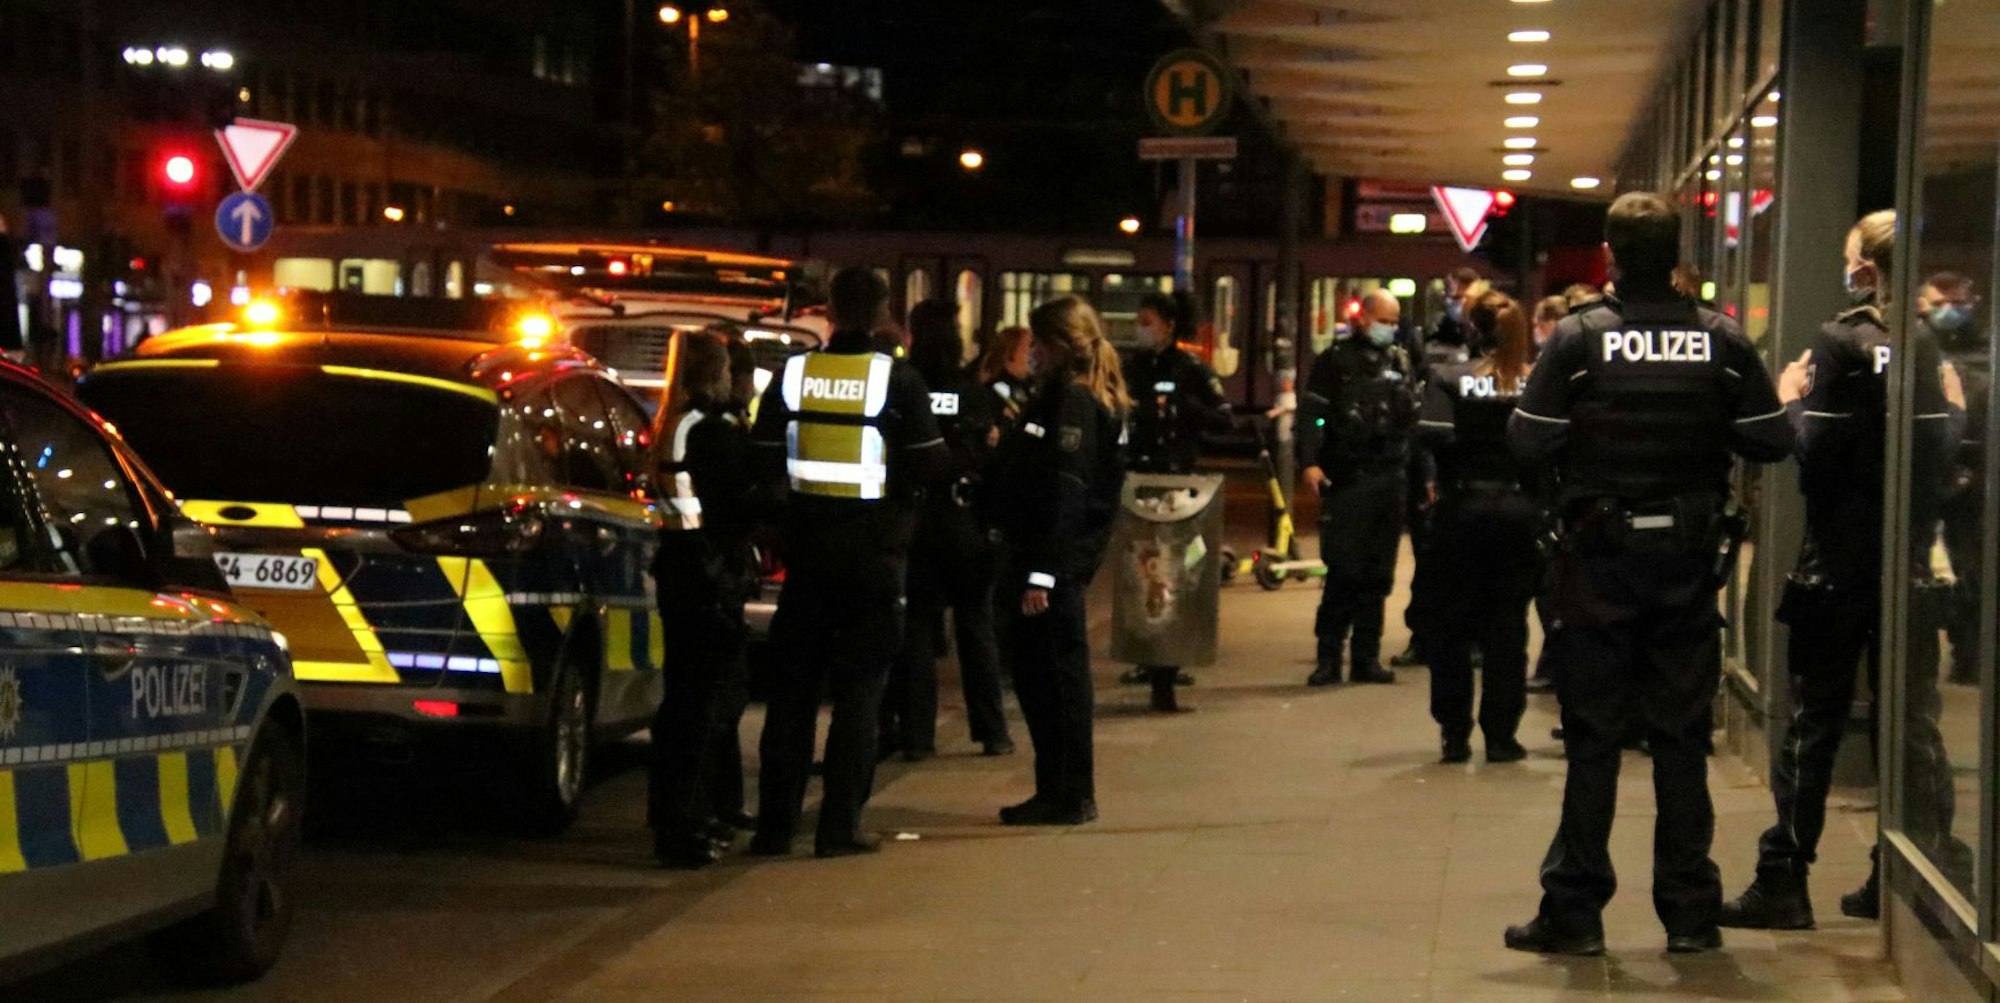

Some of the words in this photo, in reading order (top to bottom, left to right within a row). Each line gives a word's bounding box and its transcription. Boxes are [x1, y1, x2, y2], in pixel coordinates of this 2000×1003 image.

[1169, 71, 1206, 116] H
[1603, 330, 1711, 362] POLIZEI
[802, 377, 866, 401] POLIZEI
[131, 664, 207, 719] POLIZEI
